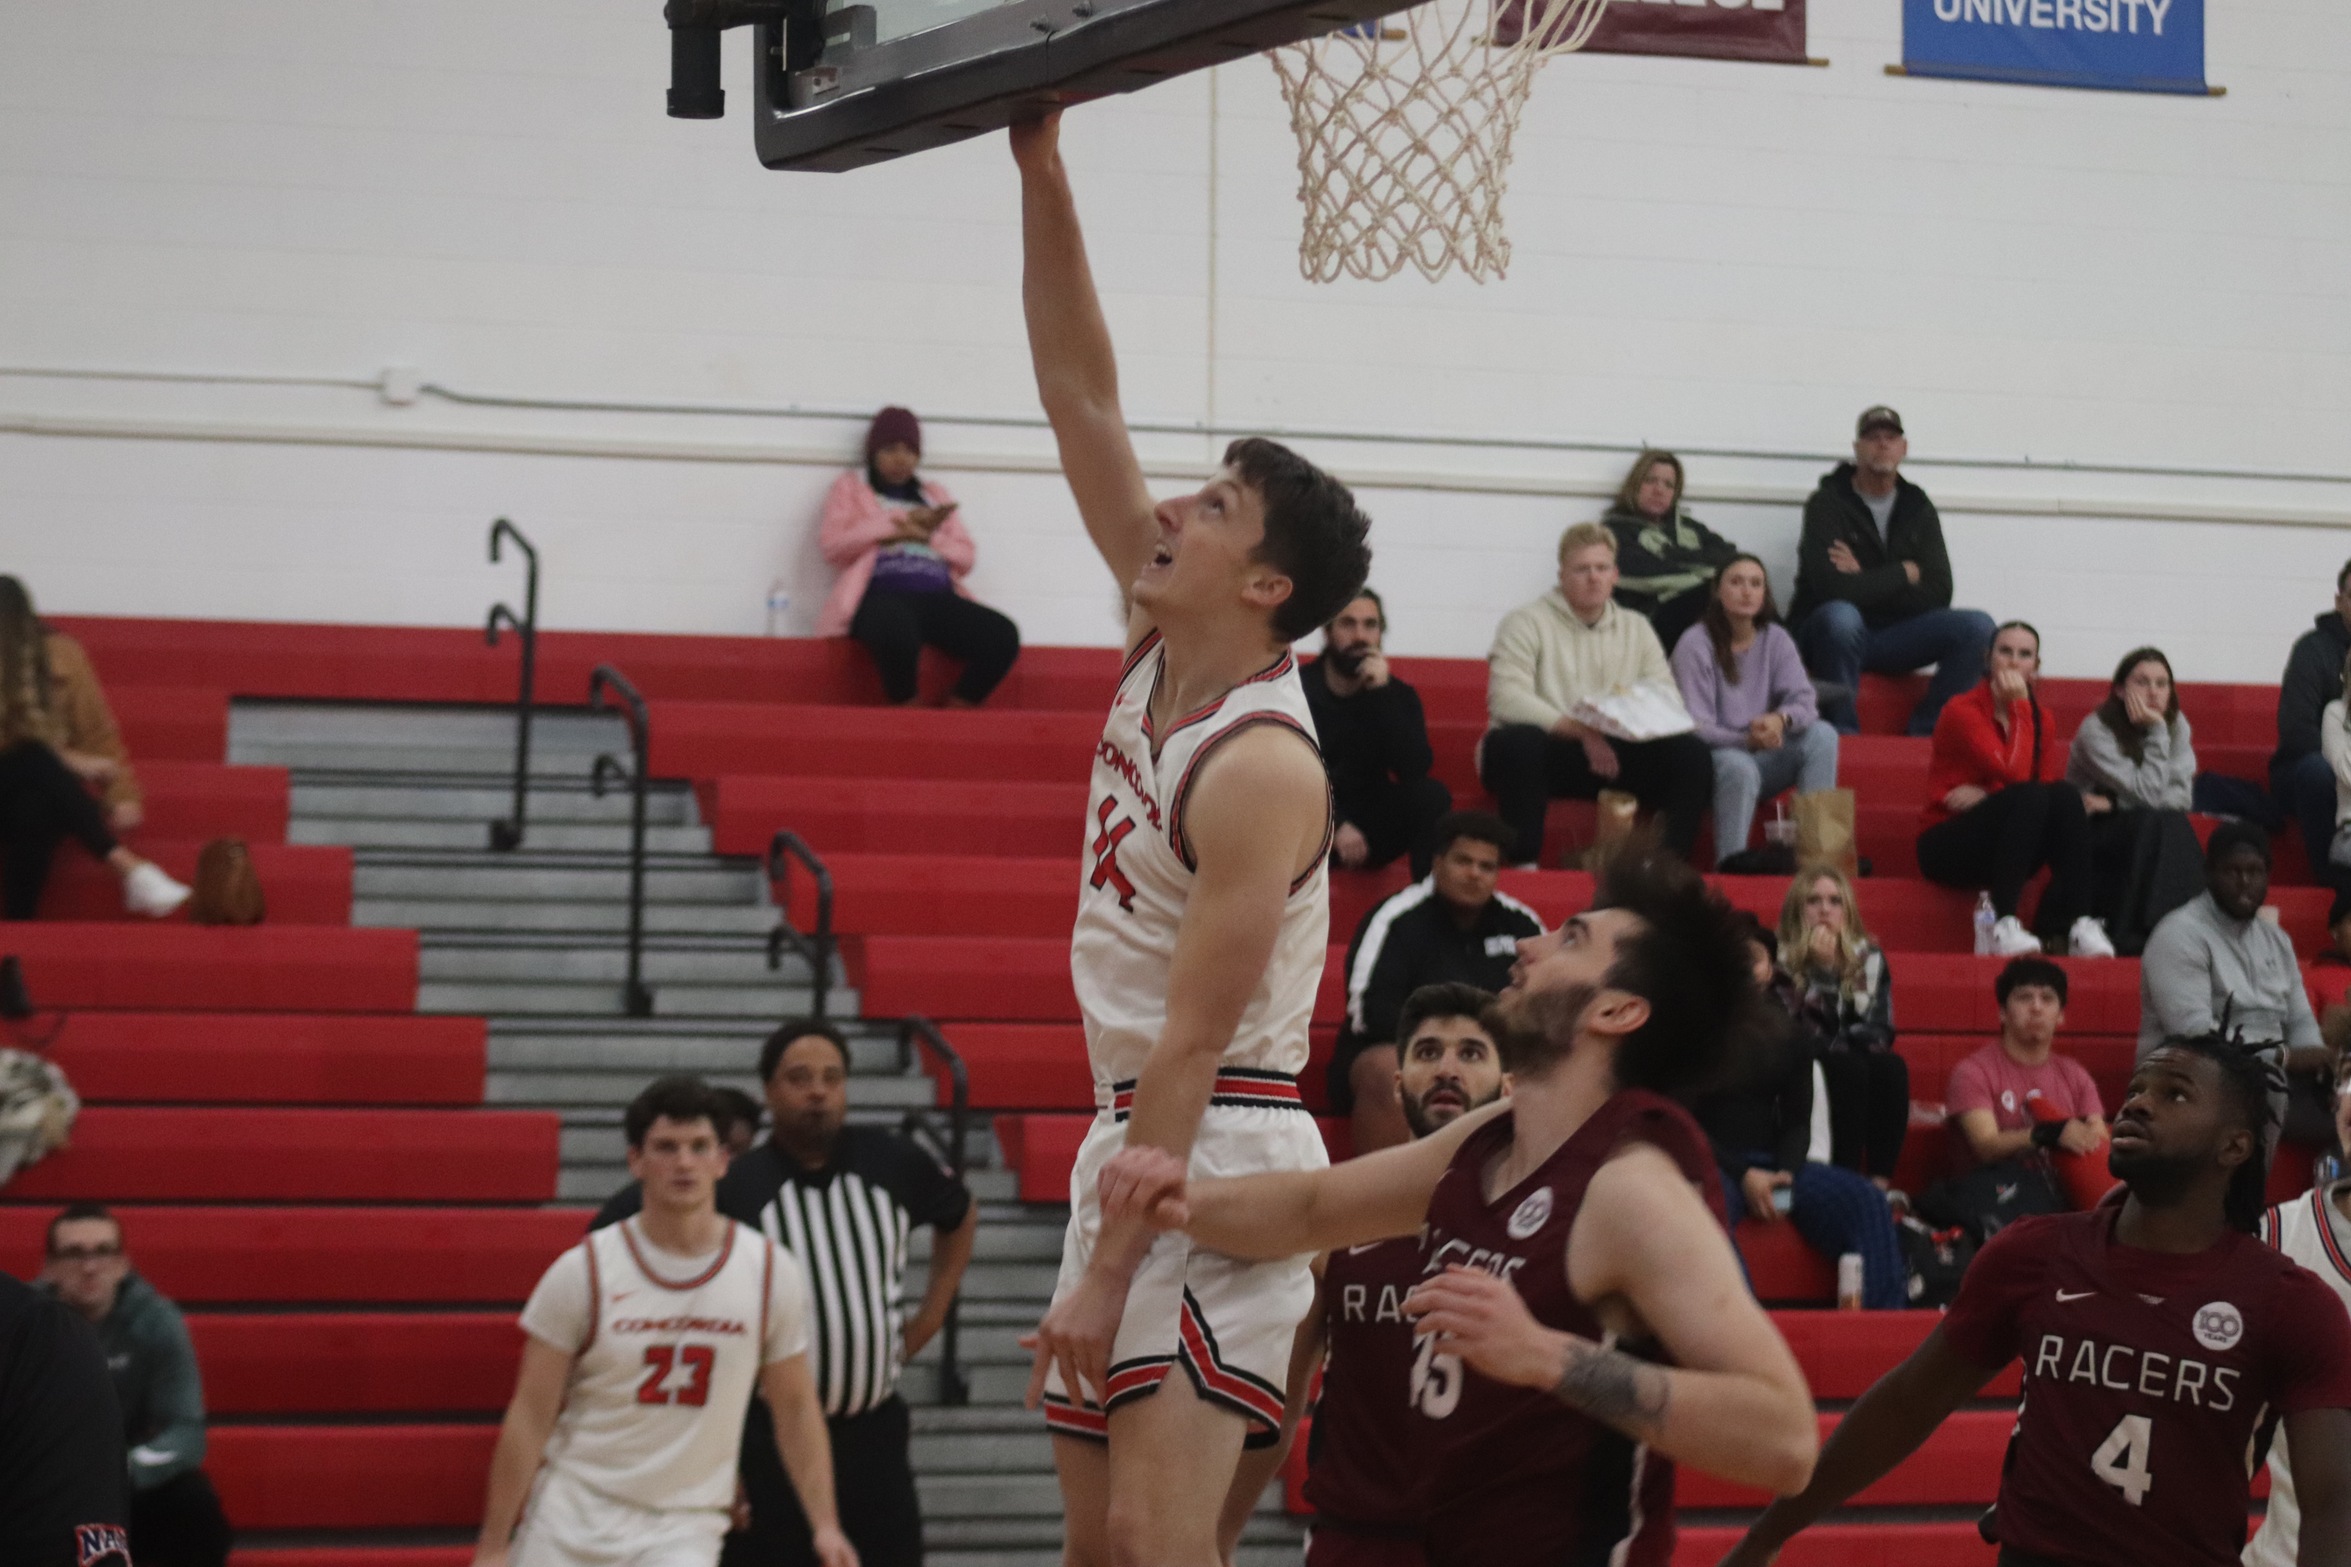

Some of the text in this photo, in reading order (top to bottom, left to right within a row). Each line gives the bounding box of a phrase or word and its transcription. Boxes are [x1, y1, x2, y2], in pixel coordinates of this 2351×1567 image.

[1932, 0, 2171, 36] UNIVERSITY
[637, 1345, 716, 1408] 23
[2034, 1335, 2241, 1412] RACERS
[2091, 1413, 2153, 1507] 4
